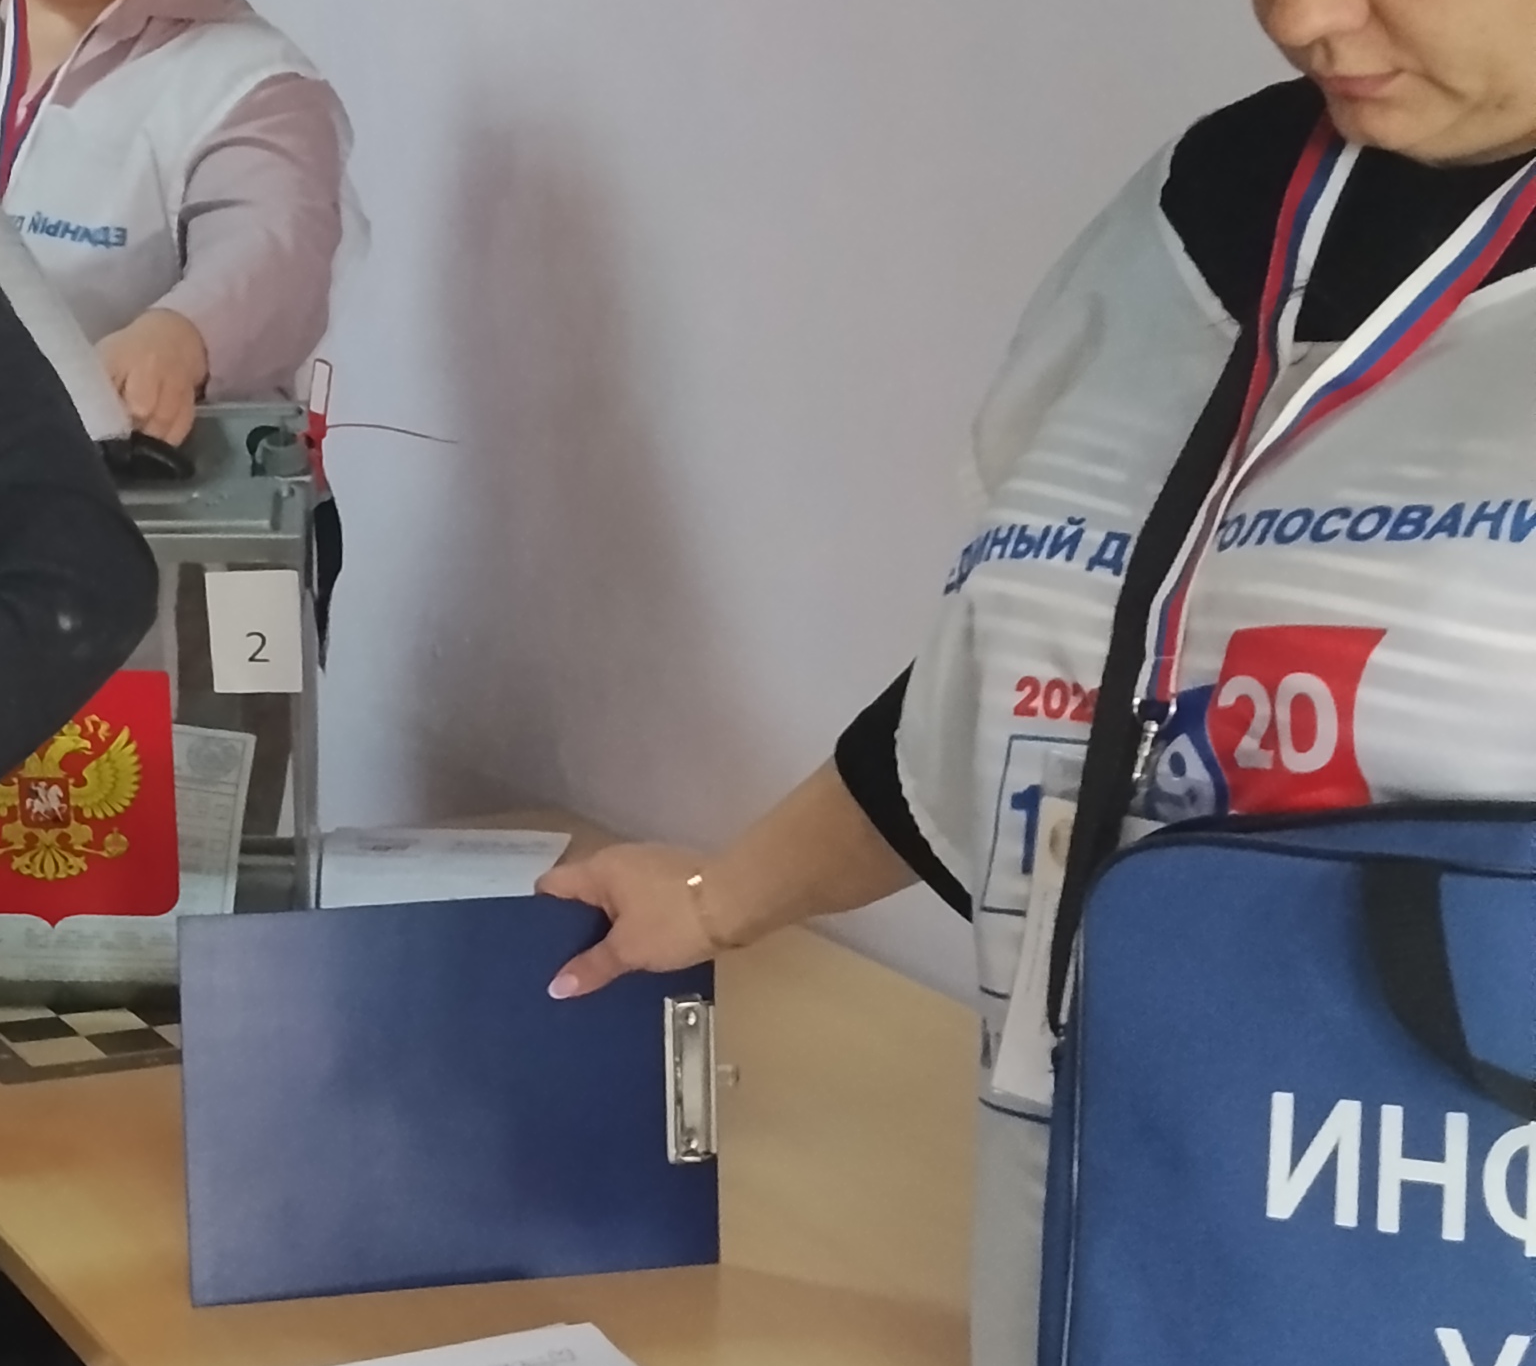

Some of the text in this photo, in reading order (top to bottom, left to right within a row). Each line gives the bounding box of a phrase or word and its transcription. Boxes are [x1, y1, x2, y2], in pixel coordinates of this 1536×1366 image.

[1216, 498, 1536, 553] ОЛОСОВАНИ
[246, 631, 270, 662] 2
[1217, 672, 1338, 773] 20
